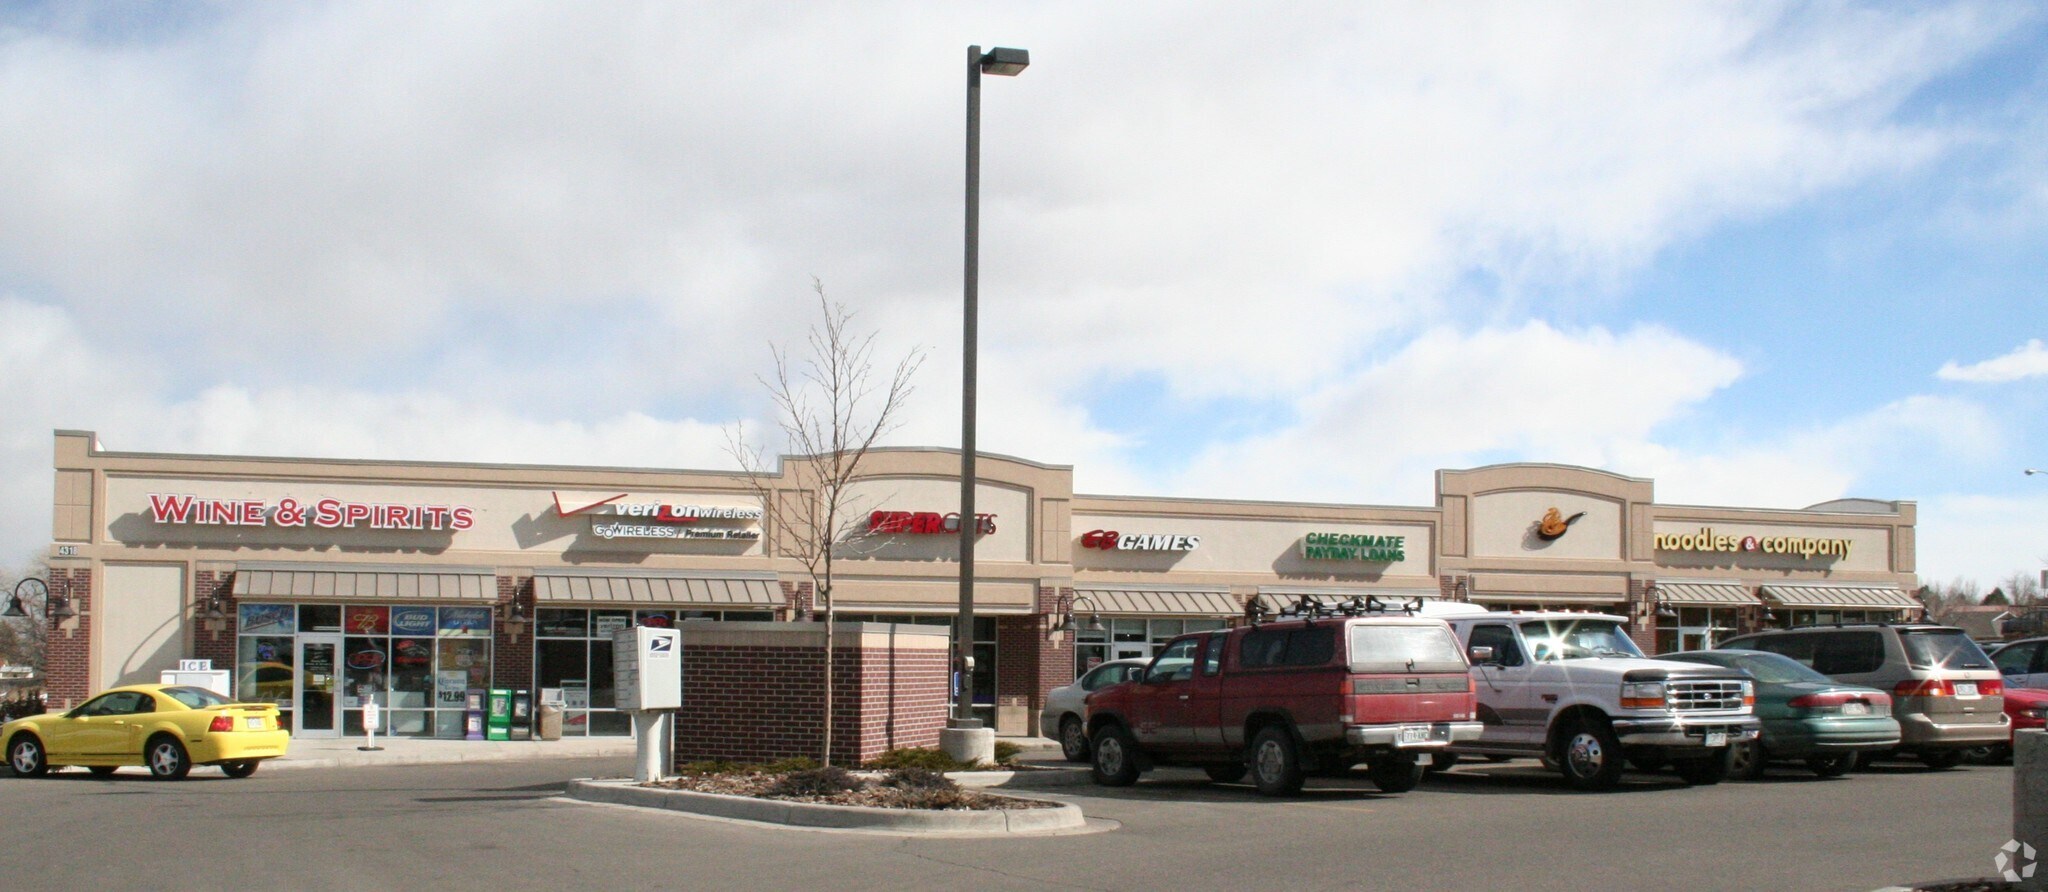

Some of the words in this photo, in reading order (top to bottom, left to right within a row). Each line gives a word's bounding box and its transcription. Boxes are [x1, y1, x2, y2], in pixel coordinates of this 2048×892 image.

[275, 497, 306, 526] &
[685, 529, 724, 539] Premium
[726, 530, 760, 540] Retailer
[1117, 534, 1201, 551] GAMES
[1305, 532, 1405, 548] CHECKMATE
[1653, 527, 1740, 552] noodles
[1744, 536, 1756, 551] &
[1762, 536, 1854, 561] company
[1305, 546, 1357, 560] PAYDAY
[1361, 548, 1405, 562] LOANS
[181, 661, 208, 671] ICE
[439, 690, 466, 702] $12.99
